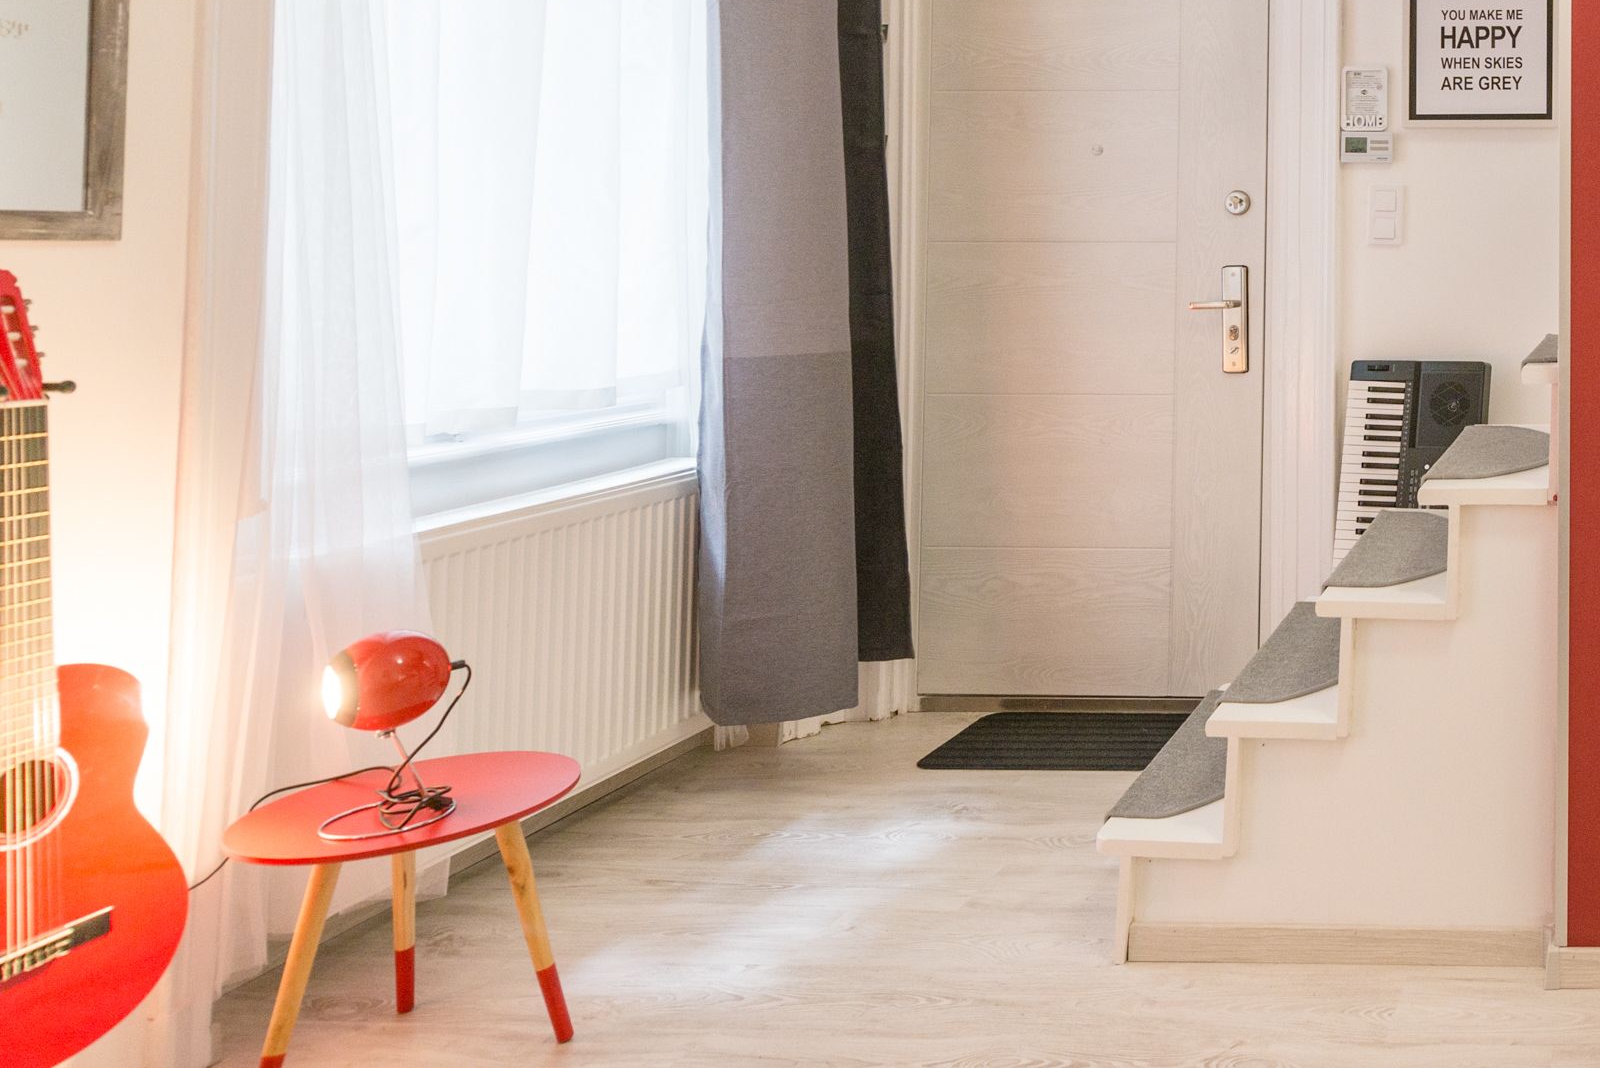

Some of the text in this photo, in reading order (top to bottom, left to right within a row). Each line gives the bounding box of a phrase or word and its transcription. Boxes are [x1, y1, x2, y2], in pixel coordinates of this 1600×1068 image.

[1441, 9, 1523, 21] YOU MAKE ME
[1440, 25, 1523, 49] HAPPY
[1441, 56, 1523, 69] WHEN SKIES
[1441, 76, 1523, 91] ARE GREY
